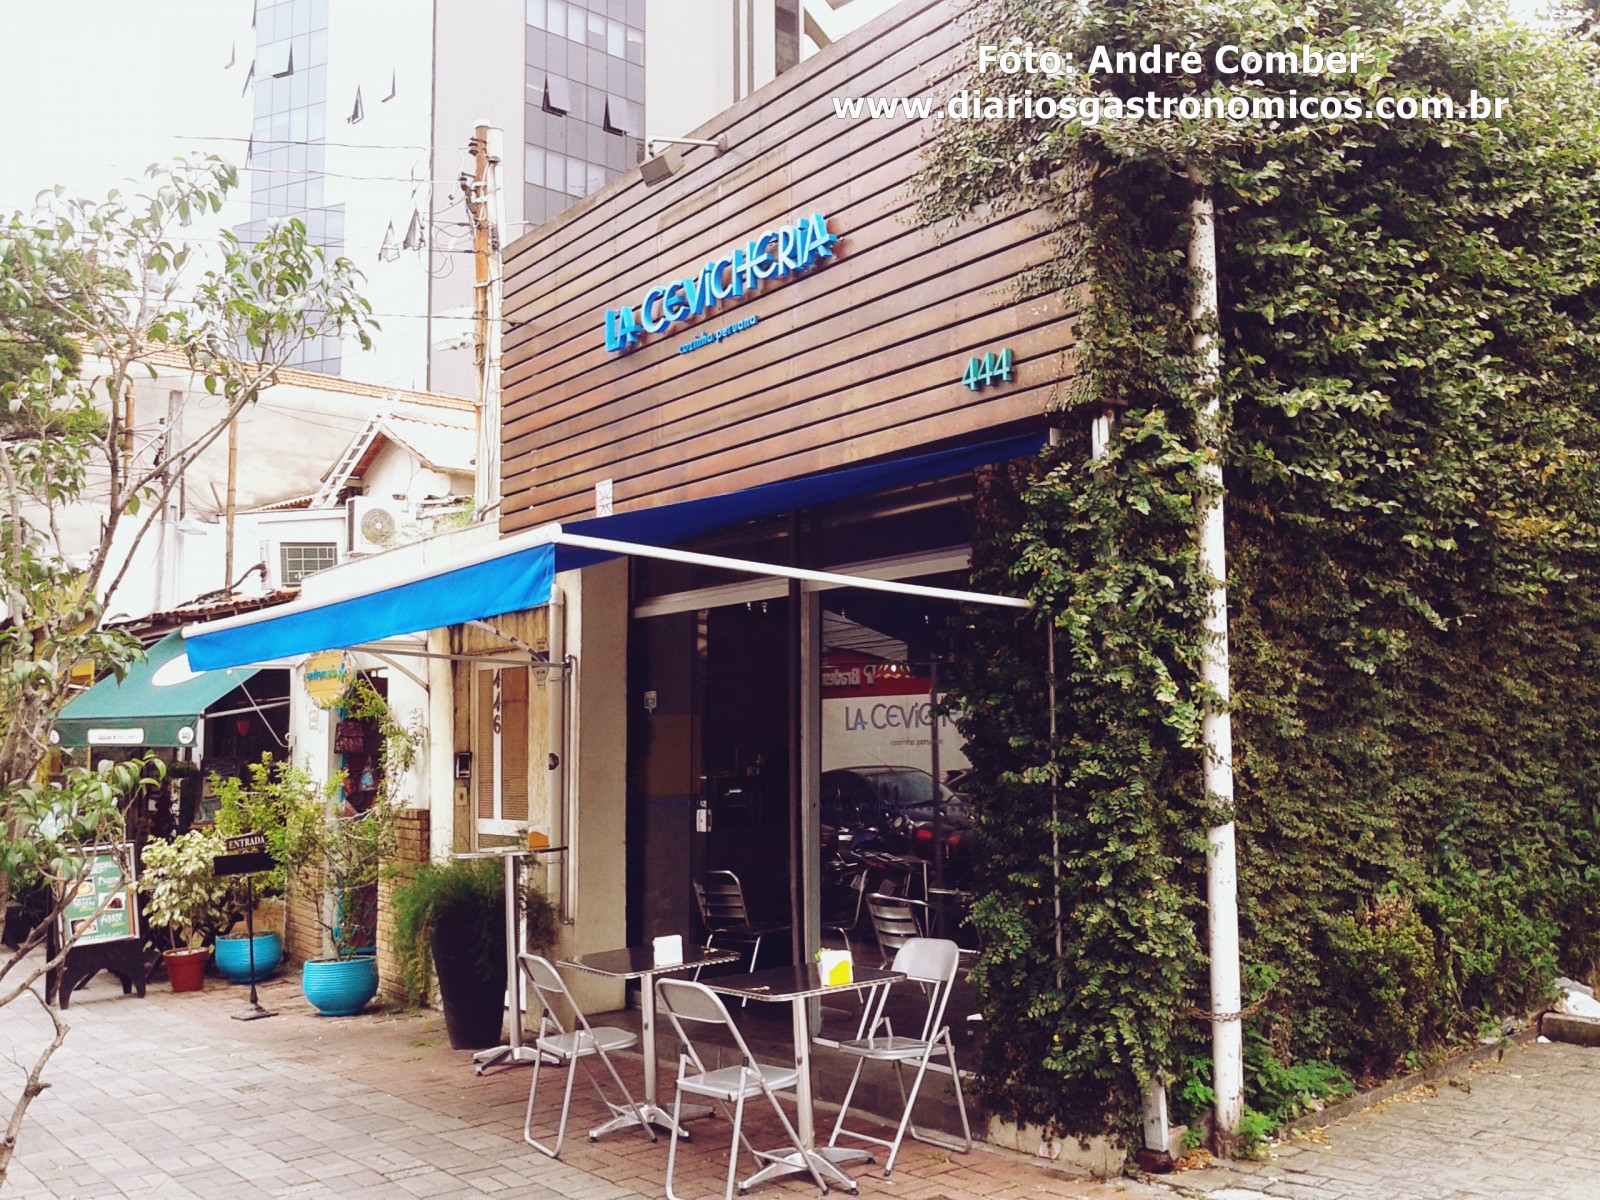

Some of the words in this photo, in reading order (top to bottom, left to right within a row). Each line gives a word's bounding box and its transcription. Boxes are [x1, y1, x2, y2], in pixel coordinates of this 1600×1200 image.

[605, 306, 643, 352] LA
[678, 331, 717, 355] cozinha
[716, 314, 759, 343] peruana
[962, 347, 1013, 391] 444
[845, 706, 868, 731] LA
[228, 835, 265, 850] ENTRADA
